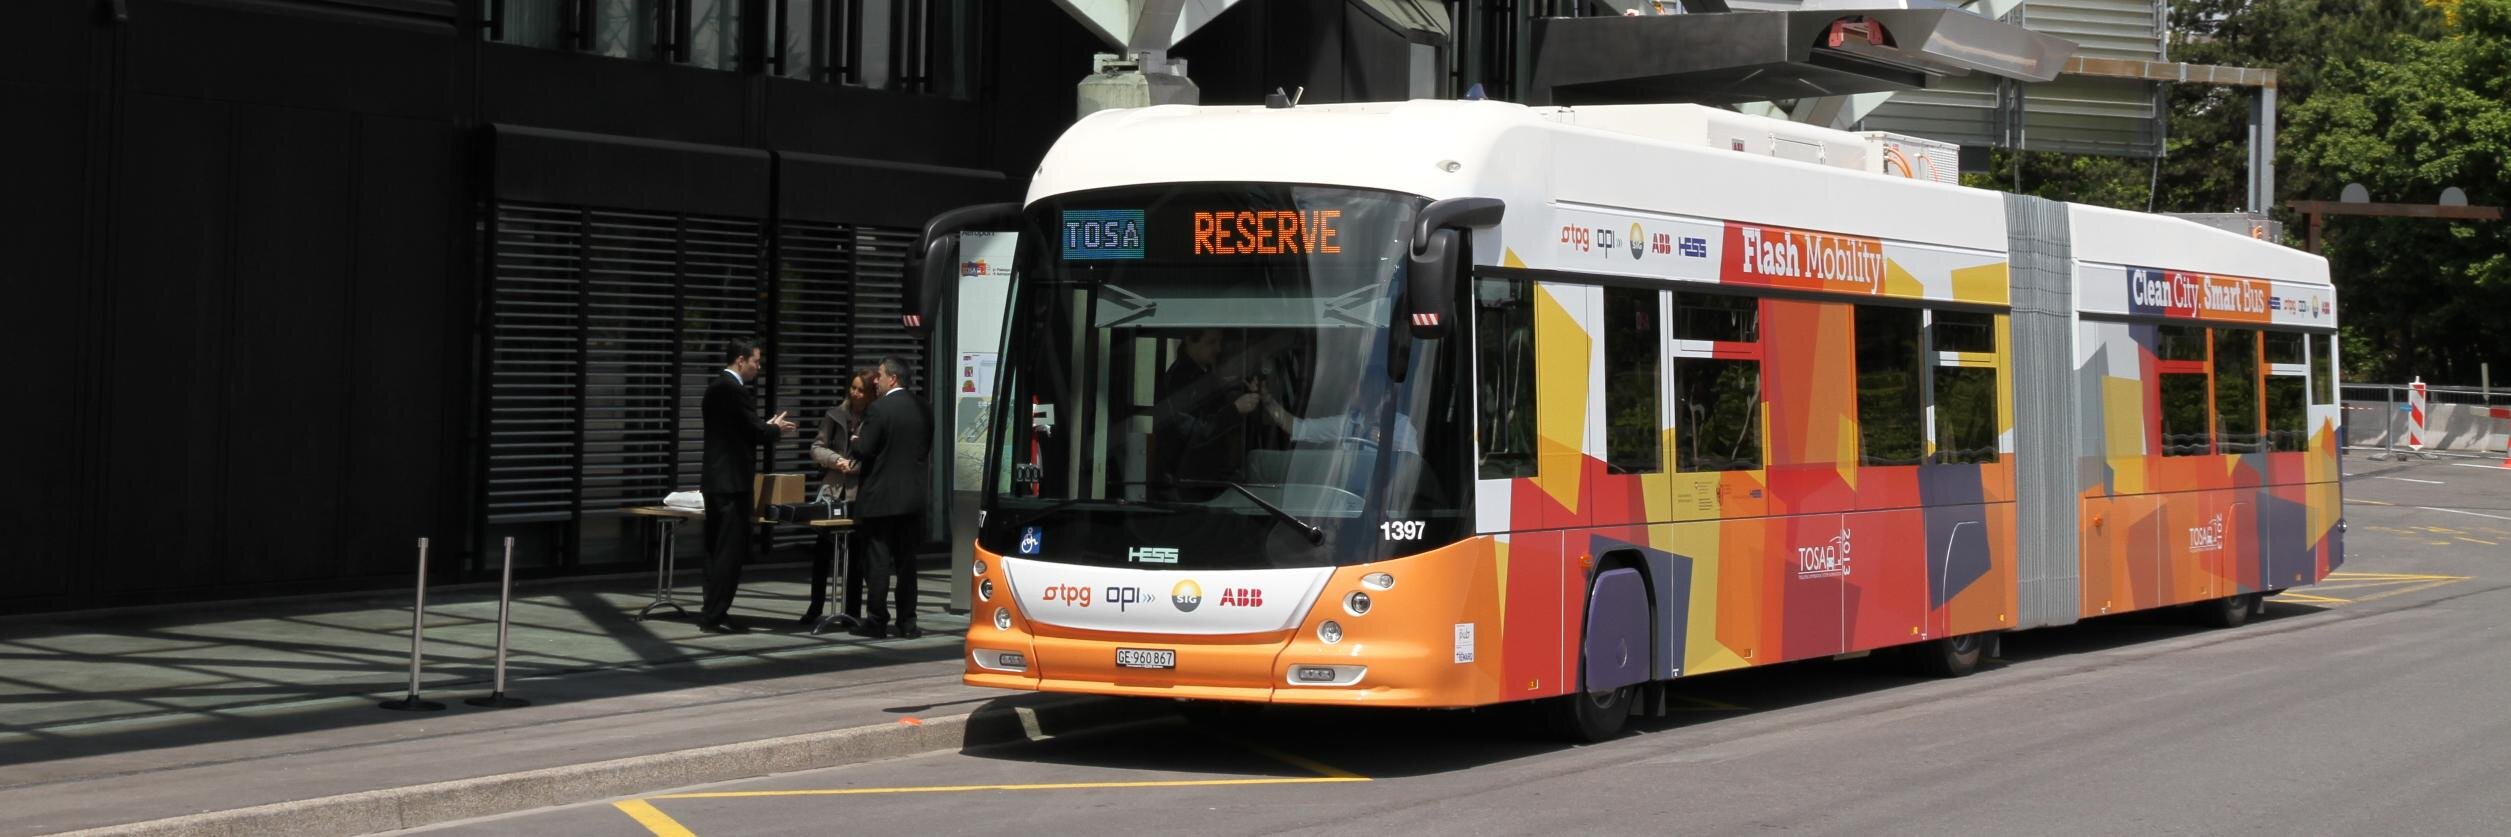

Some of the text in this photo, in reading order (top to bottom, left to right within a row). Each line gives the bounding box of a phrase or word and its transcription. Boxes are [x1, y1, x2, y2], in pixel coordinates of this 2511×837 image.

[1066, 222, 1139, 248] TOSA
[1195, 210, 1341, 254] RESERVE
[1652, 233, 1671, 254] ABB
[1678, 236, 1706, 258] HESS
[1742, 226, 1881, 295] Flash Mobility
[2133, 269, 2172, 307] Clean
[2203, 275, 2241, 311] Smart
[2242, 280, 2265, 313] Bus
[1380, 521, 1426, 541] 1397
[1128, 547, 1179, 564] HESS
[1798, 546, 1827, 572] TOSA
[1842, 528, 1851, 576] 2013
[1176, 594, 1198, 604] SIG
[1219, 588, 1263, 607] ABB
